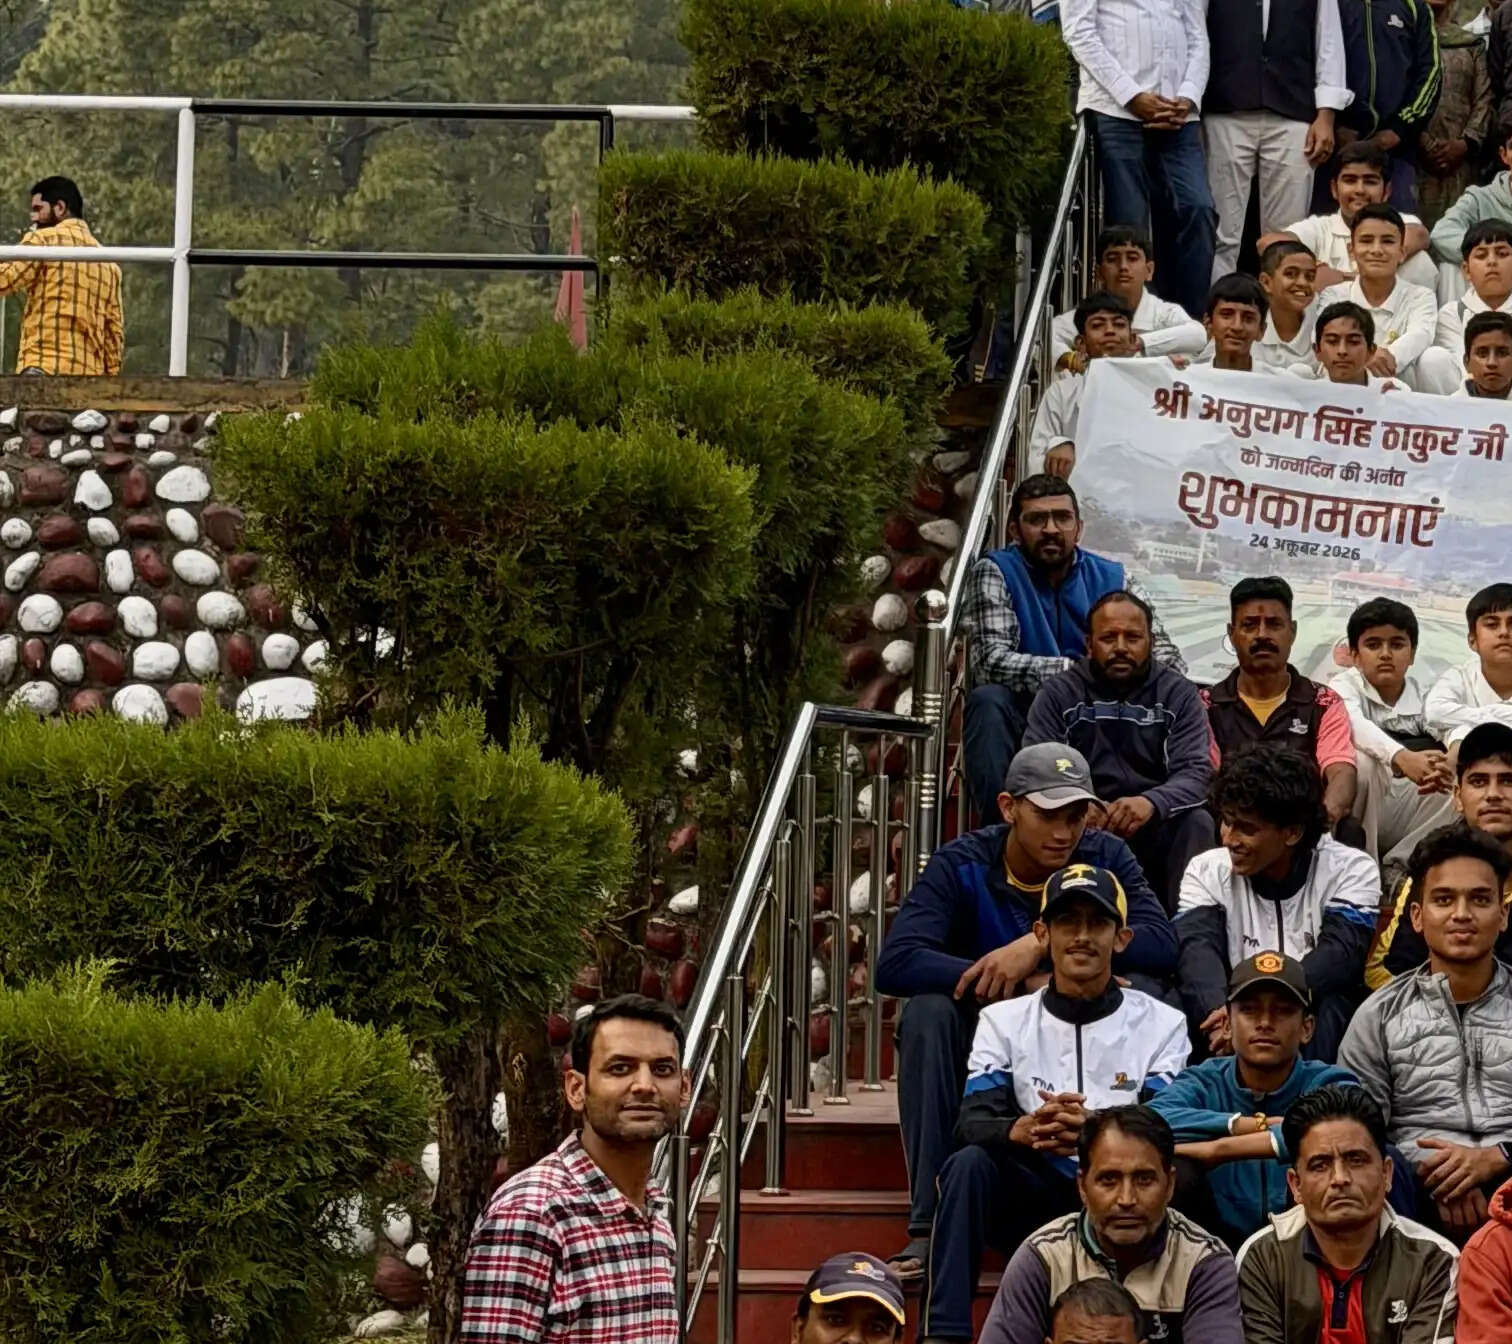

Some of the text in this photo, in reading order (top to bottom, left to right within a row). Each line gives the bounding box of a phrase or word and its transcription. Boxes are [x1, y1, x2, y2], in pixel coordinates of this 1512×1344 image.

[1152, 381, 1509, 463] श्री अनुराग सिंह ठाकुर जी
[1240, 446, 1407, 487] को जन्मदिन की अनंत
[1178, 471, 1444, 547] शुभकामनाएं
[1249, 533, 1269, 548] 24
[1323, 544, 1361, 560] 2026
